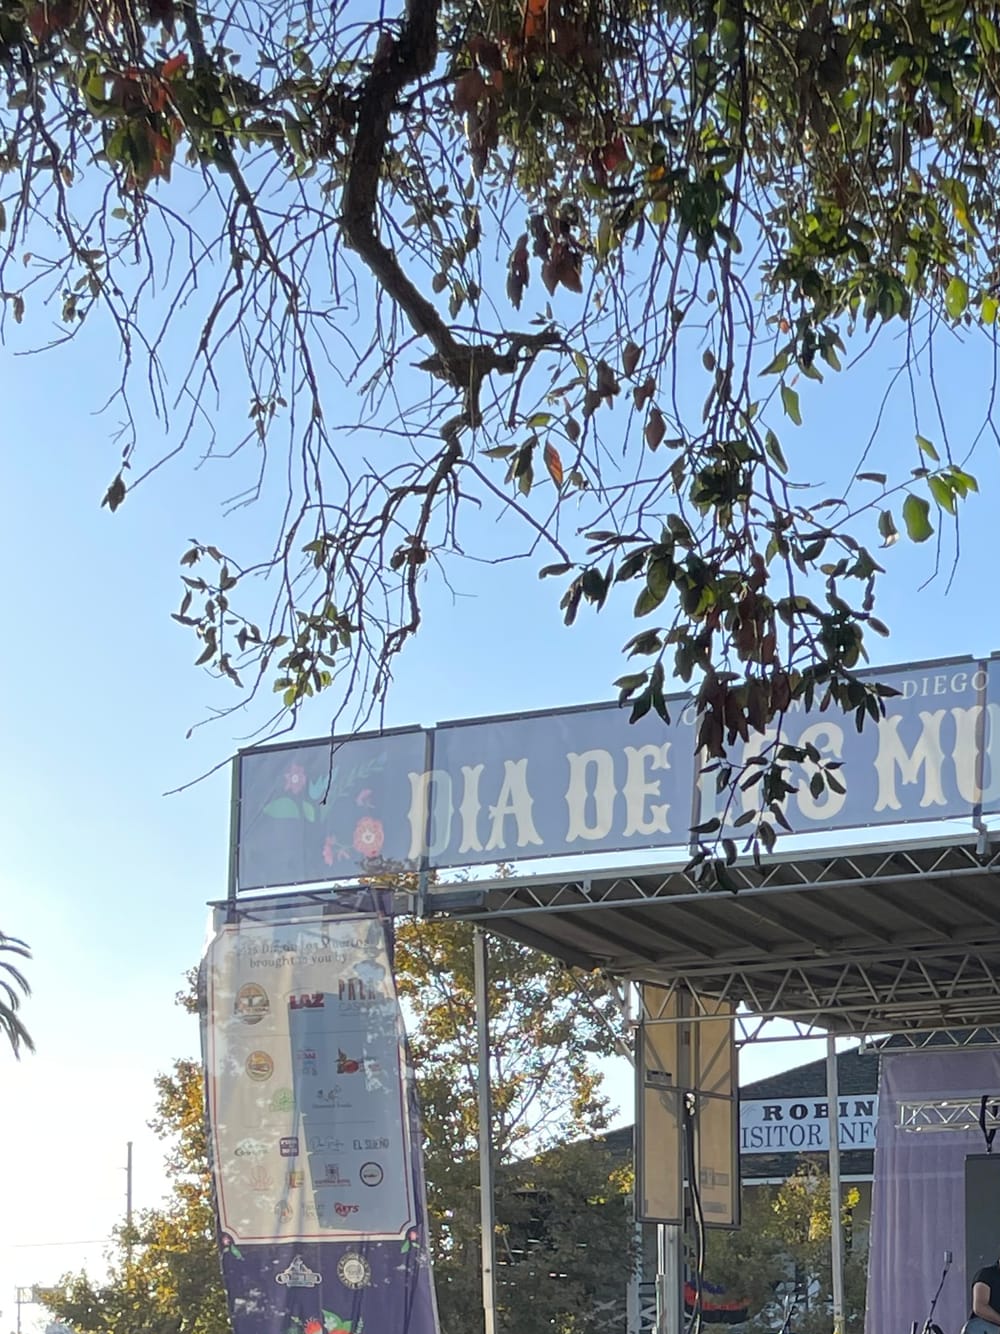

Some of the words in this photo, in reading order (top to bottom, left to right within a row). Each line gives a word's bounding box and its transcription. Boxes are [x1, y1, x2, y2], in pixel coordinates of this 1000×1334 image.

[902, 670, 990, 700] DIEGO
[407, 758, 544, 860] DIA
[564, 742, 672, 843] DE
[312, 954, 332, 968] you
[289, 992, 325, 1010] LAZ
[742, 1124, 823, 1148] ISITOR
